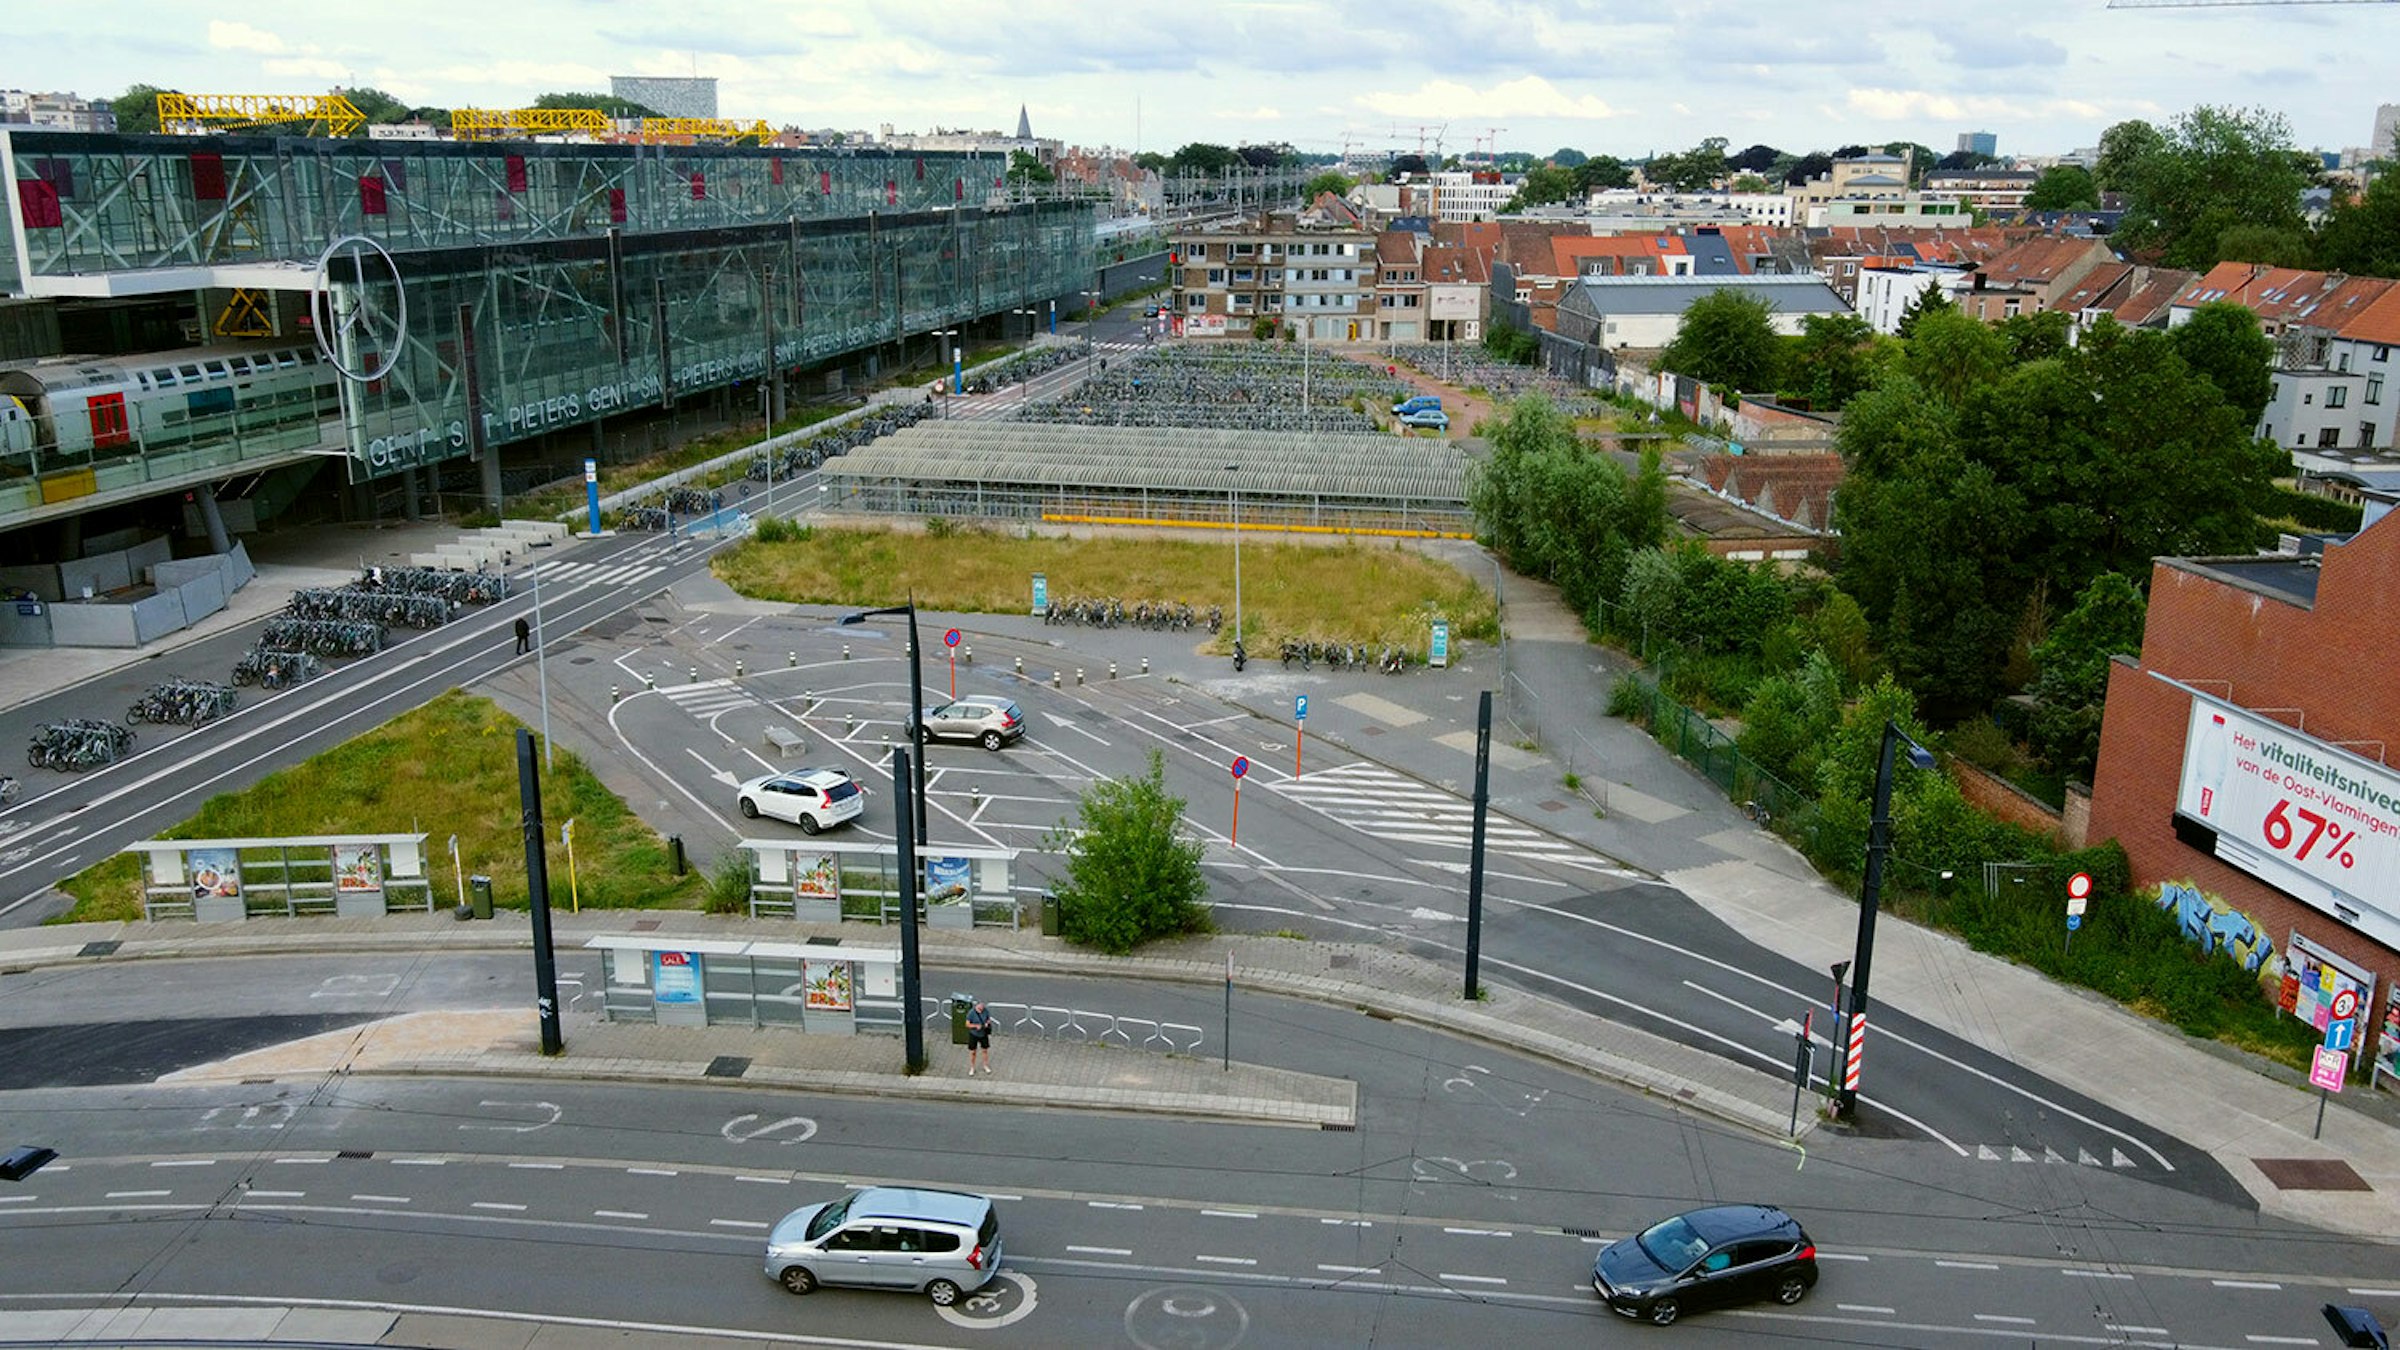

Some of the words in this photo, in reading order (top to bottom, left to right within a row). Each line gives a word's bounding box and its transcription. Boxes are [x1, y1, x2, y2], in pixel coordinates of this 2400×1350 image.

[588, 381, 630, 411] GENT
[640, 374, 663, 399] SIN
[681, 355, 734, 388] PIETERS
[369, 427, 428, 467] GENT
[509, 393, 580, 433] PIETERS
[1297, 697, 1307, 711] P
[2233, 731, 2256, 751] Het
[2236, 757, 2260, 775] van
[2263, 767, 2280, 785] de
[2283, 776, 2400, 838] Oost-Vlamingen
